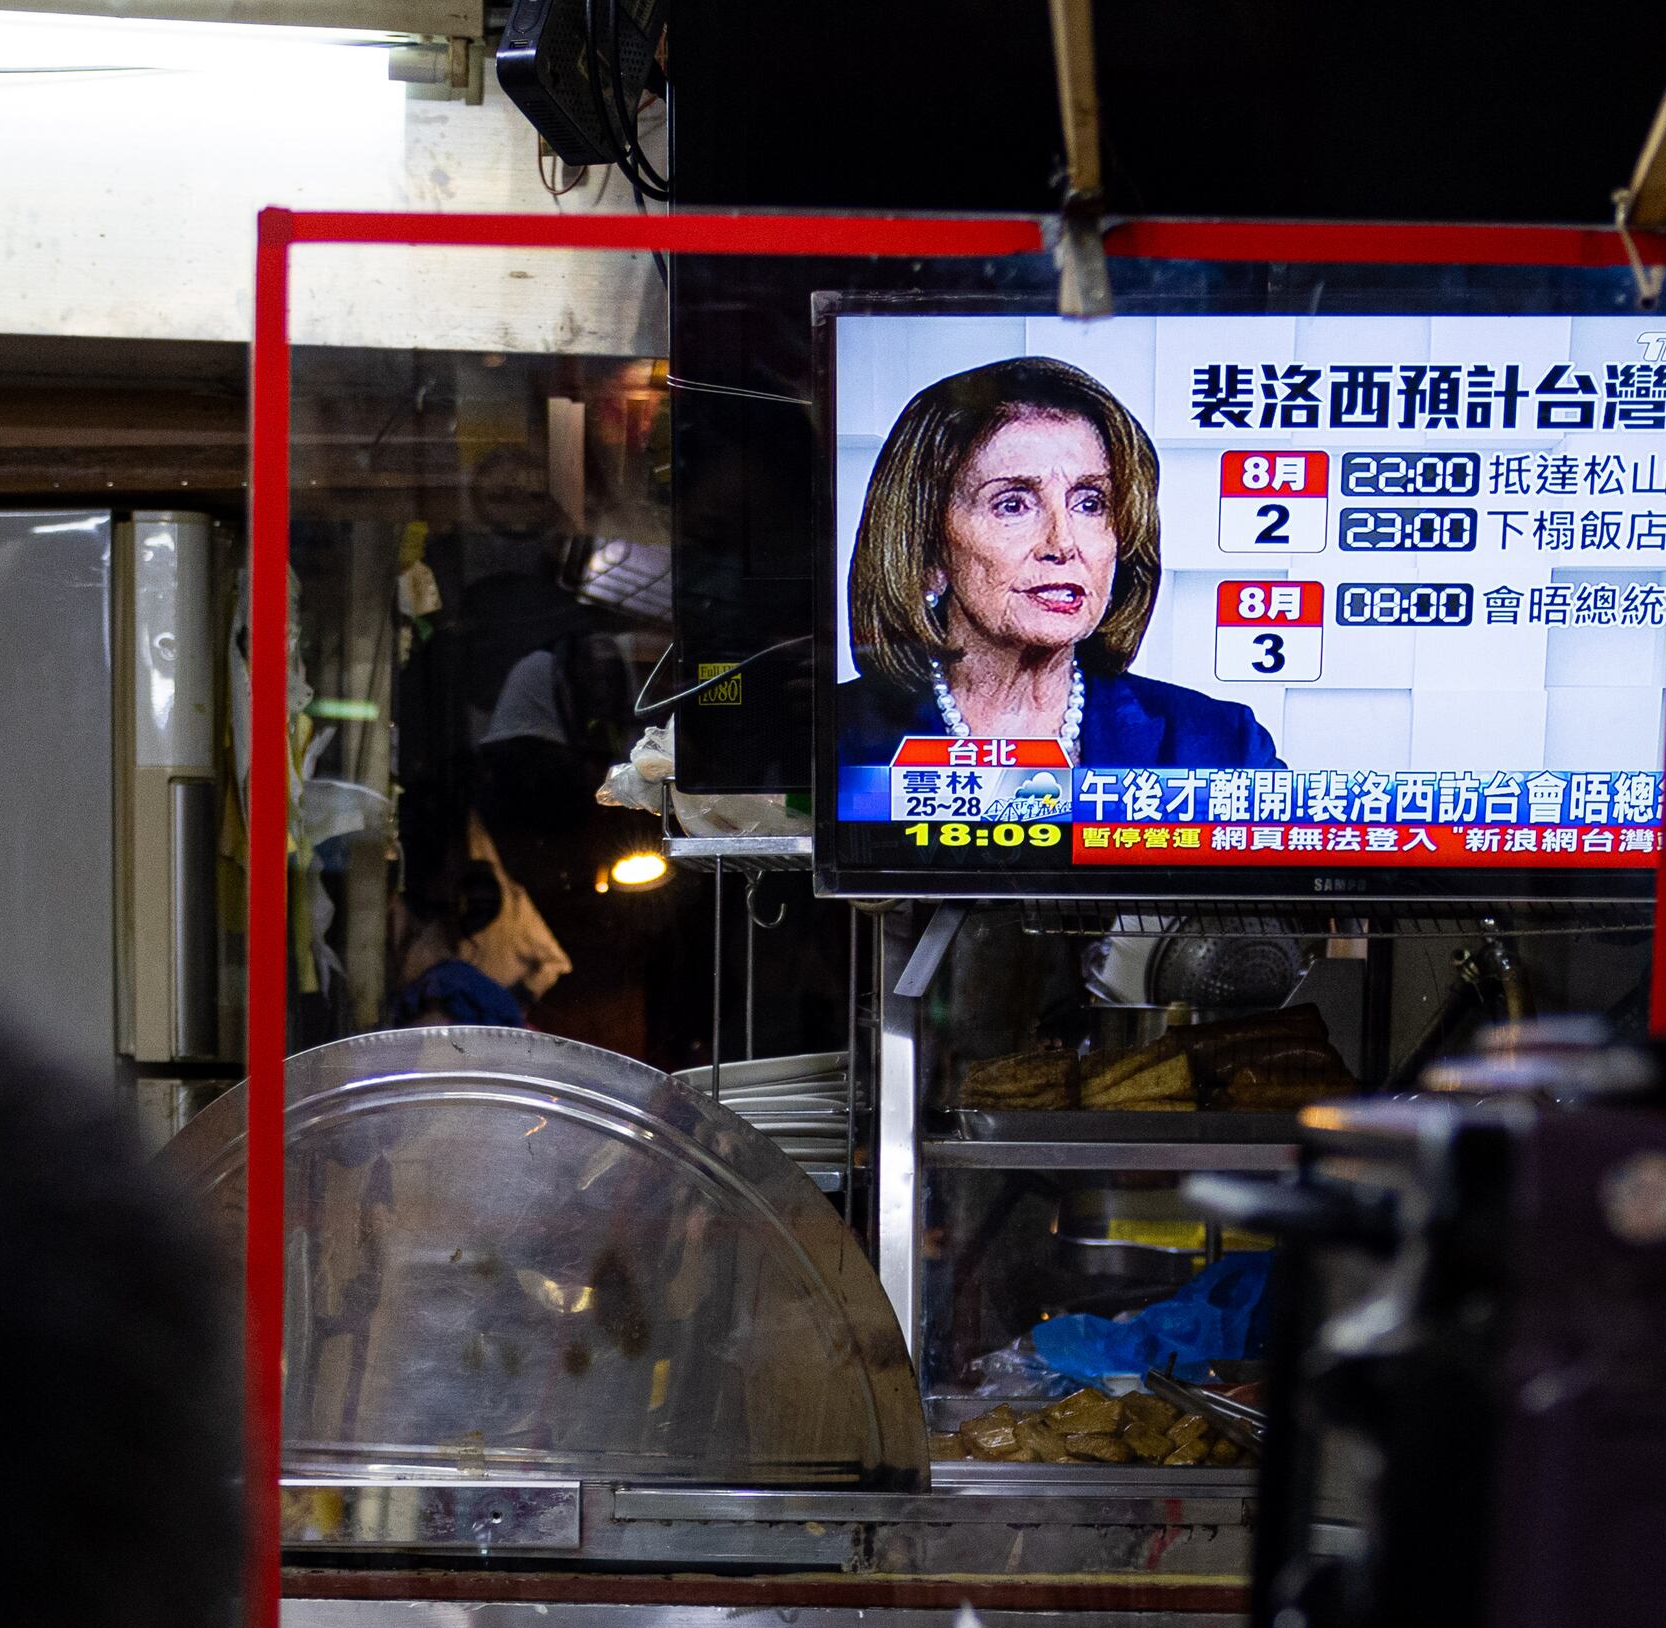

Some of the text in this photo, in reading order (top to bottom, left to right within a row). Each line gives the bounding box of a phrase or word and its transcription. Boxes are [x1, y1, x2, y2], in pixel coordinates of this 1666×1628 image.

[1241, 456, 1307, 493] 8月
[1347, 456, 1475, 494] 22:00
[1254, 503, 1290, 544] 2
[1345, 512, 1471, 549] 23:00
[1237, 585, 1302, 621] 8月
[1343, 586, 1465, 623] 08:00
[1251, 633, 1285, 674] 3
[946, 739, 1018, 767] 台北
[902, 770, 984, 795] 雲林
[905, 796, 982, 818] 25~28
[904, 823, 1062, 847] 18:09
[1082, 827, 1201, 849] 暫停營運
[1211, 826, 1438, 853] 網頁無法登入
